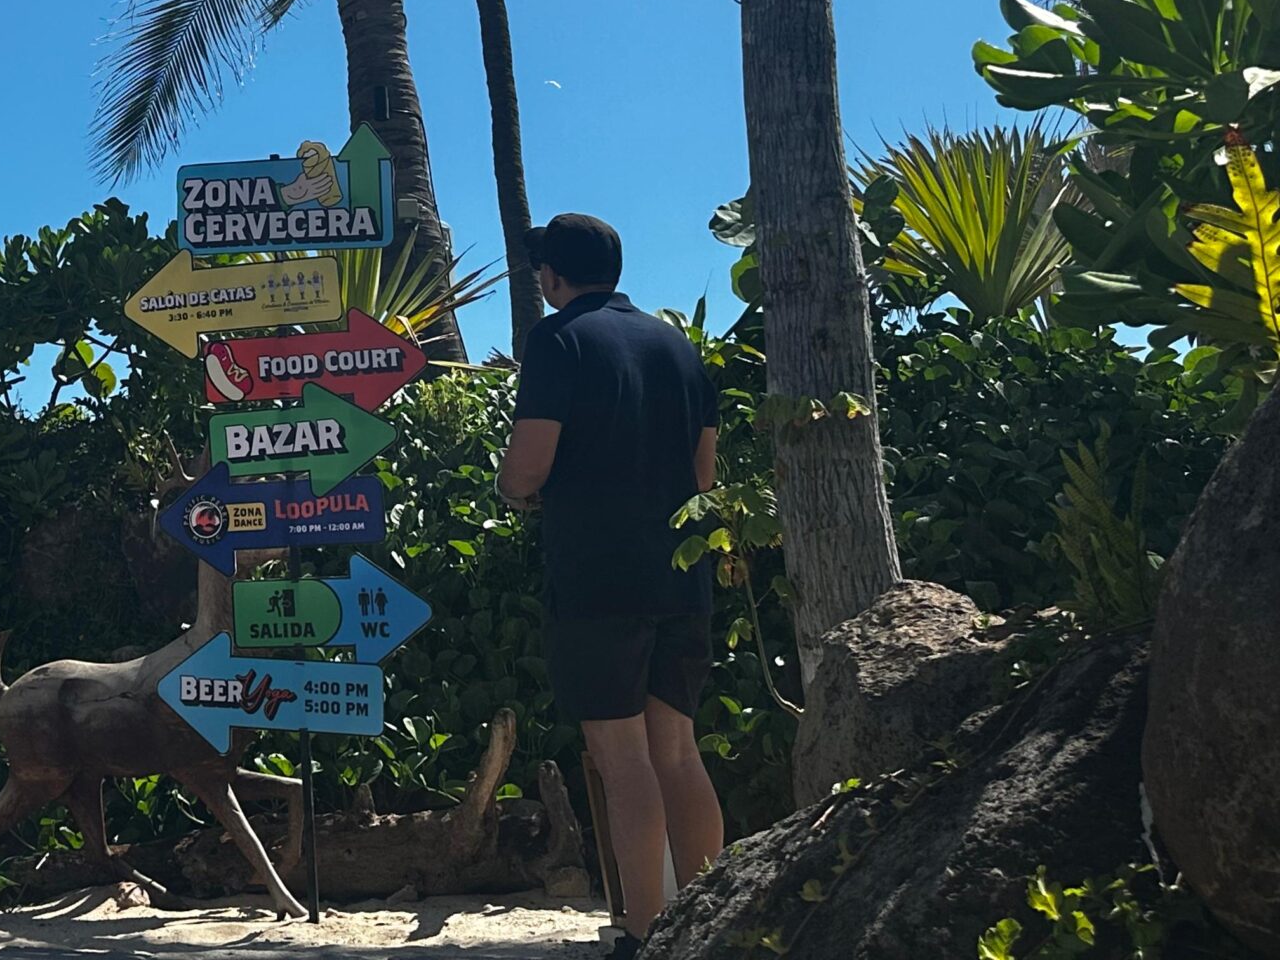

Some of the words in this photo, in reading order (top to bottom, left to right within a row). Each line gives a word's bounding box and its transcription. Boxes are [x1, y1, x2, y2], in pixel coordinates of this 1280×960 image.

[183, 178, 276, 209] ZONA
[184, 207, 376, 244] CERVECERA
[140, 290, 186, 312] SALÓN
[189, 292, 208, 306] DE
[210, 286, 255, 303] CATAS
[219, 308, 233, 317] PM
[257, 352, 320, 379] FOOD
[324, 346, 403, 373] COURT
[225, 418, 345, 460] BAZAR
[233, 507, 263, 518] ZONA
[274, 494, 370, 519] LOOPULA
[233, 518, 264, 528] DANCE
[288, 525, 307, 533] 7:00
[308, 524, 322, 533] PM
[328, 522, 350, 531] 12:00
[352, 522, 365, 530] AM
[249, 621, 316, 639] SALIDA
[361, 621, 391, 638] WC
[180, 675, 244, 704] BEER
[236, 669, 297, 721] Yoga
[303, 680, 340, 695] 4:00
[345, 682, 369, 697] PM
[304, 700, 340, 714] 5:00
[345, 702, 369, 717] PM
